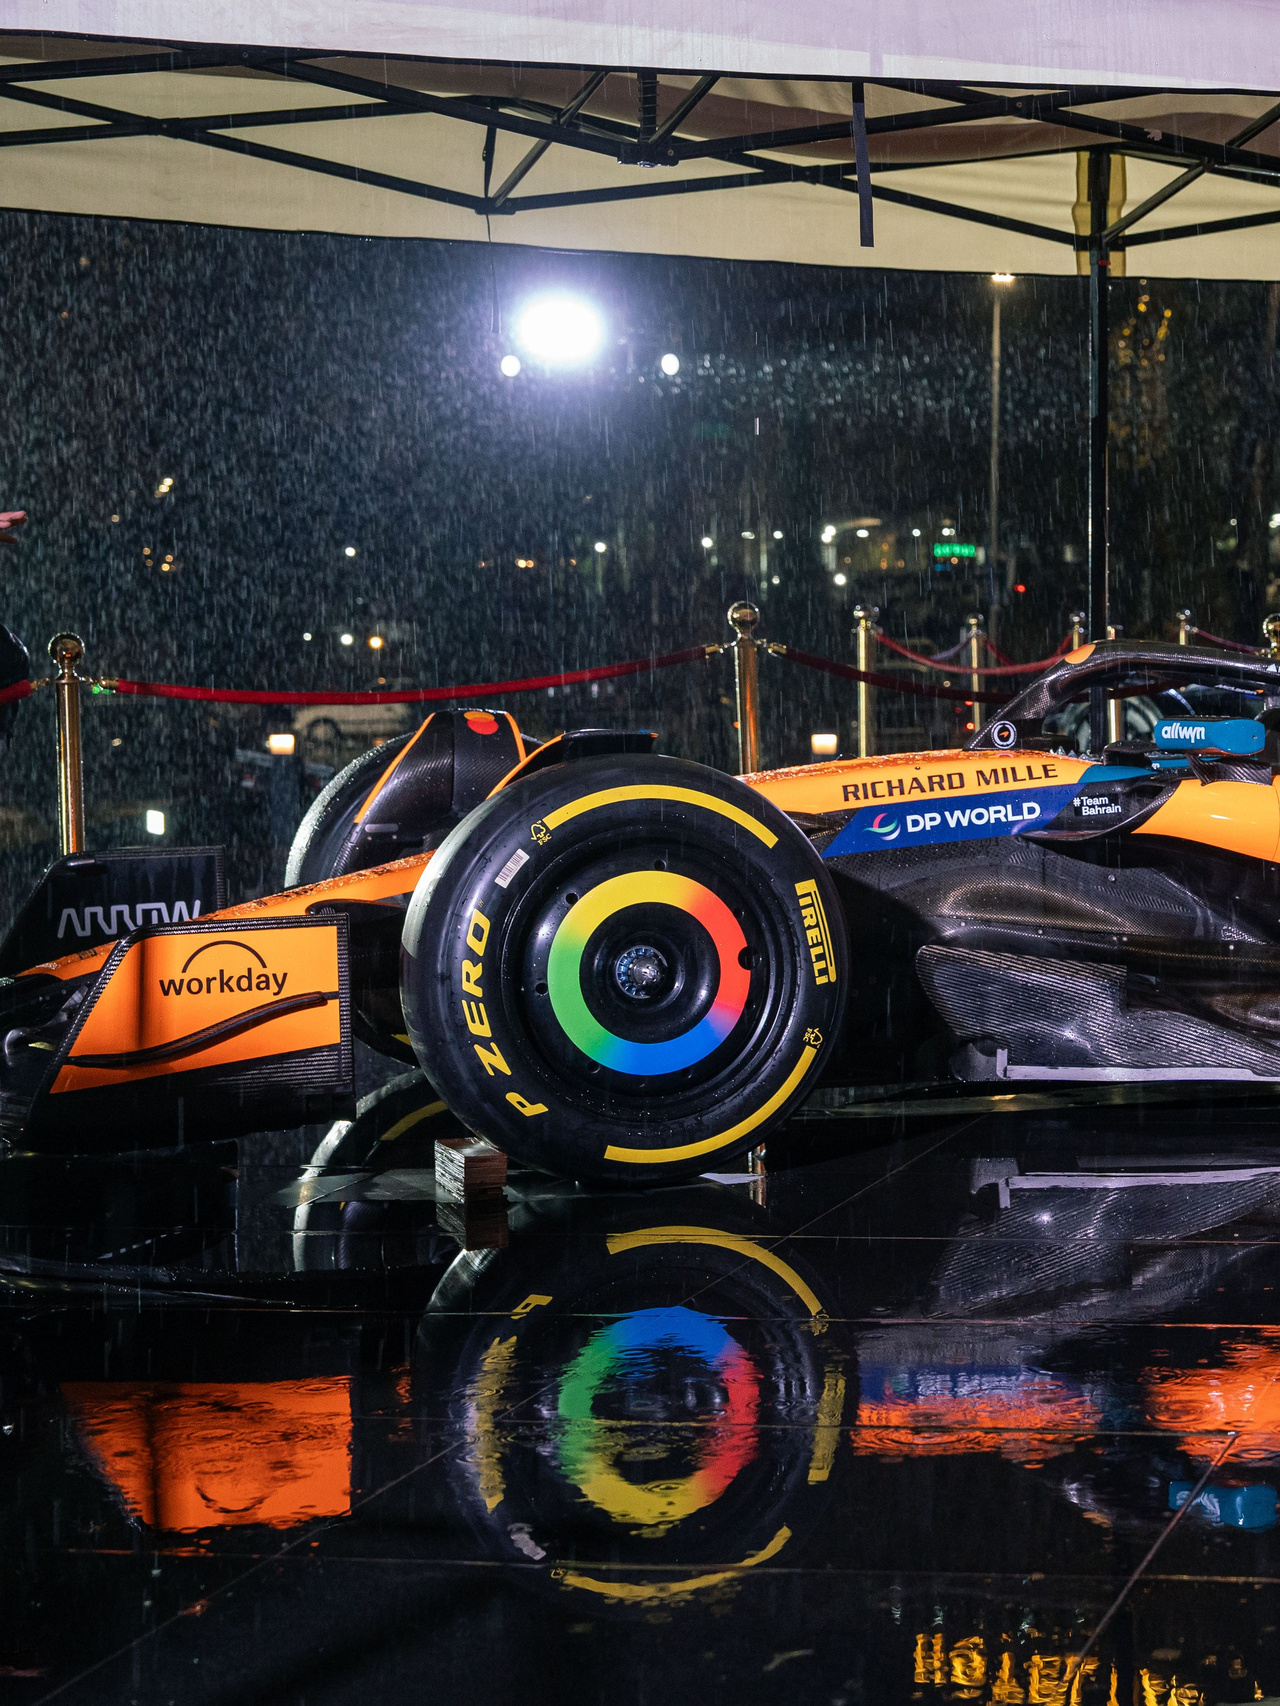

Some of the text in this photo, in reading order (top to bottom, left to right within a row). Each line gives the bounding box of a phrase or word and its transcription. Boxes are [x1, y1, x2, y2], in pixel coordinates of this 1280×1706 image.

[1161, 722, 1205, 743] allwyn
[842, 763, 1059, 802] RICHARD MILLE
[1073, 796, 1109, 807] #Team
[1082, 803, 1122, 816] Bahrain
[906, 802, 1041, 834] DP WORLD
[794, 878, 837, 986] PIRELLI
[159, 966, 288, 996] workday
[461, 908, 549, 1117] P ZERO
